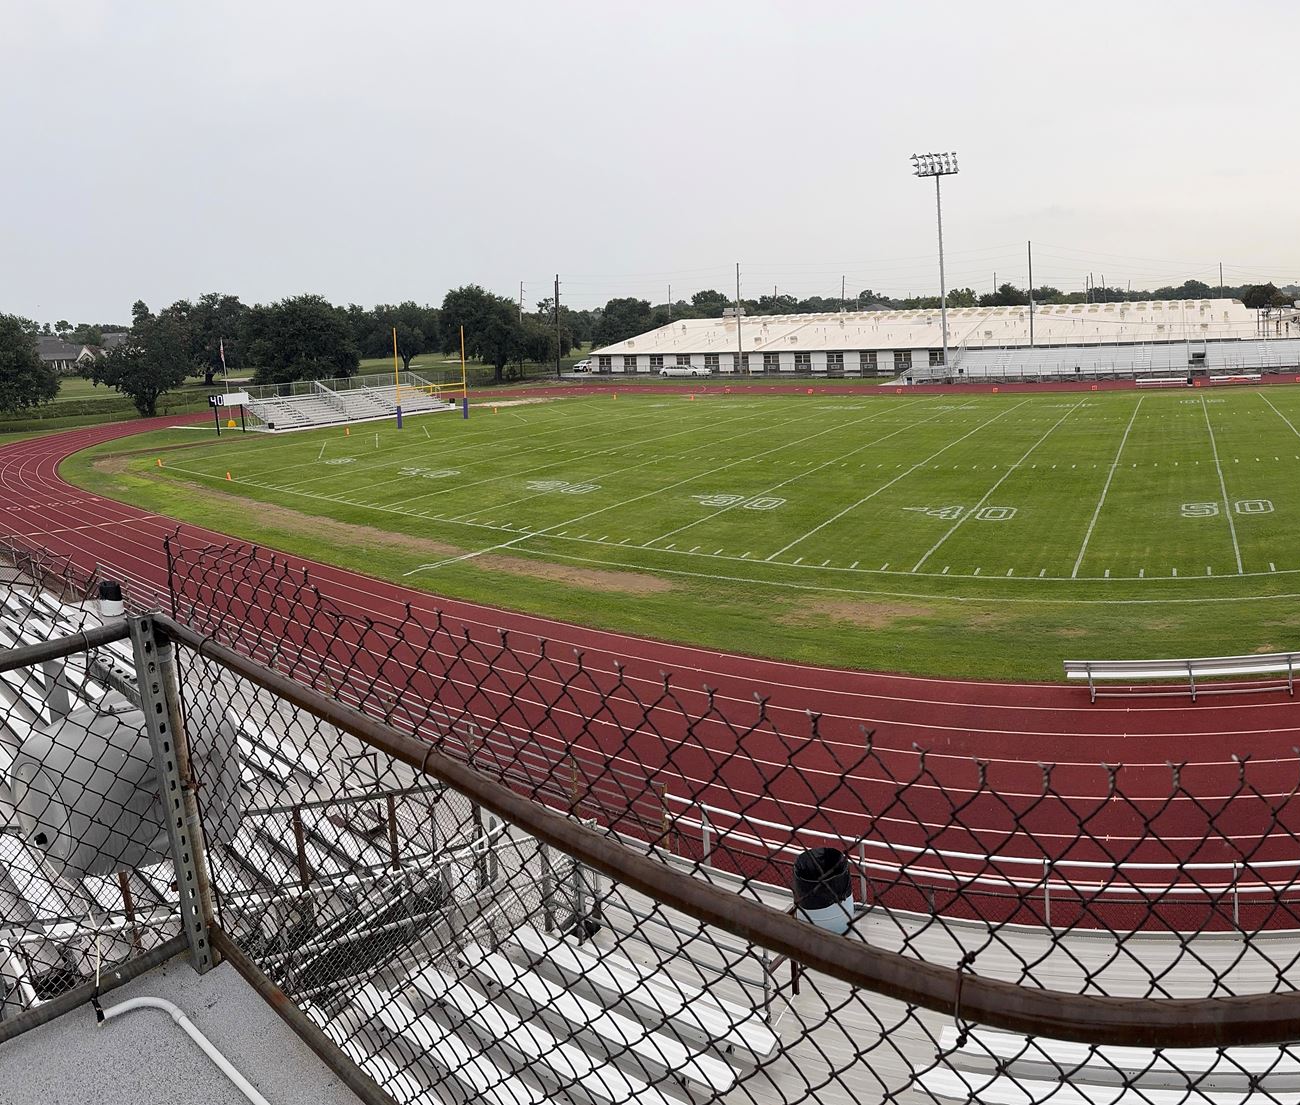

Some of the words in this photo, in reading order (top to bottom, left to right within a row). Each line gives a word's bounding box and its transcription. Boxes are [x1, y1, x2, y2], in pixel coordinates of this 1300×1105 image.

[210, 395, 224, 405] 40
[700, 494, 787, 511] 30
[1181, 499, 1275, 517] 50
[926, 505, 1018, 520] 40
